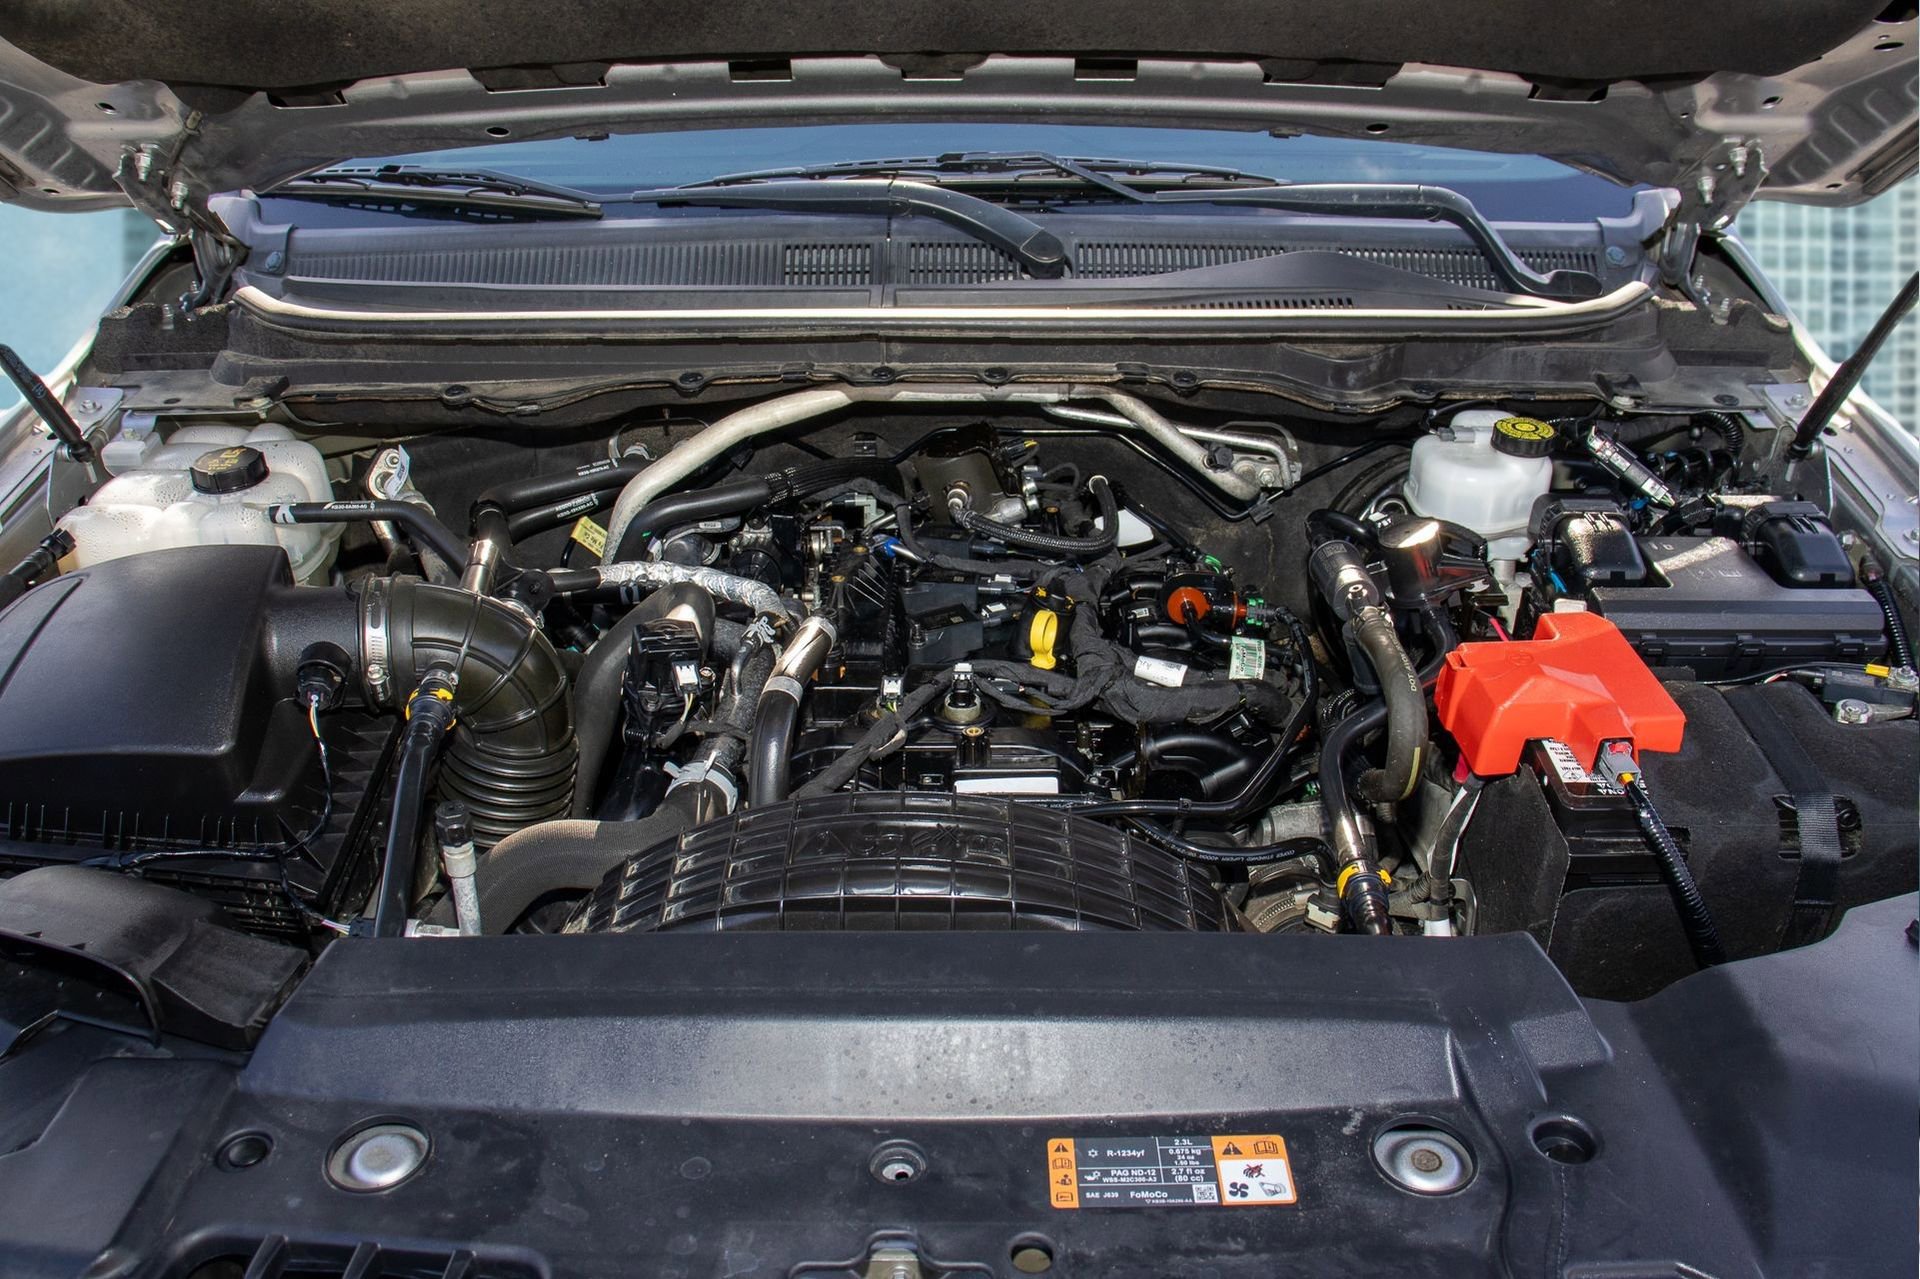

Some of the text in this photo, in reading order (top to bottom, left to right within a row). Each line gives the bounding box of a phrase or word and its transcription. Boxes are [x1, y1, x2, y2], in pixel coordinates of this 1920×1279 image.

[1173, 1138, 1193, 1146] 2.3L
[1106, 1149, 1145, 1158] R-1234yf
[1190, 1148, 1202, 1156] kg
[1110, 1168, 1157, 1177] PAG ND-12
[1130, 1190, 1169, 1199] FoMoCo
